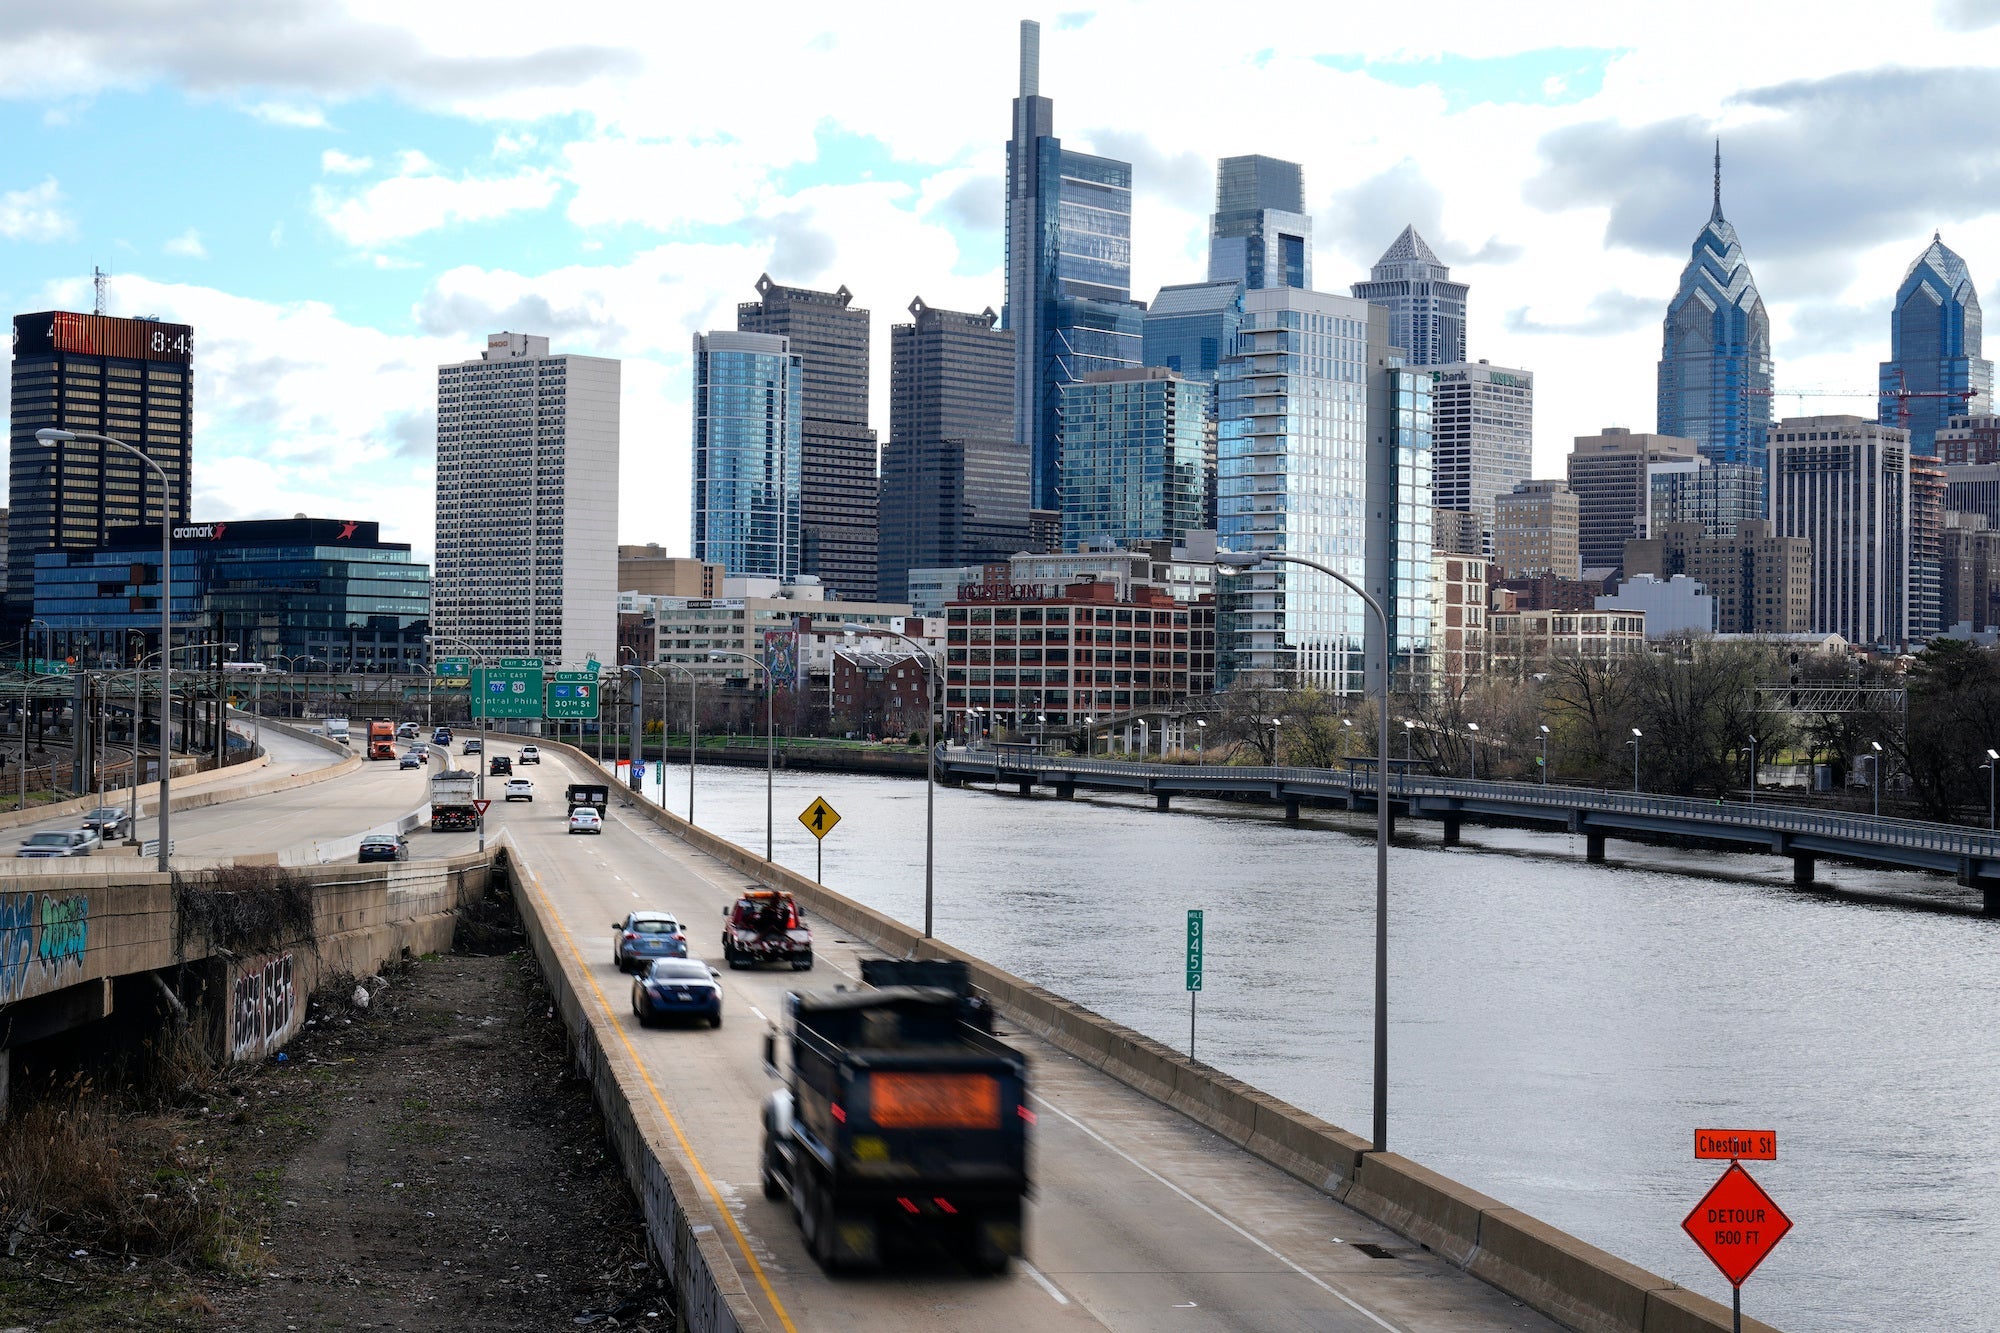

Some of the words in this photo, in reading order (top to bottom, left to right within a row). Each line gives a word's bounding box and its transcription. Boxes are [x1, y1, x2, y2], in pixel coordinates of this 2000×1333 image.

[1442, 371, 1467, 382] bank
[173, 524, 214, 539] aramark
[1005, 583, 1046, 599] POINT
[491, 684, 504, 692] 676
[513, 683, 524, 691] 30
[555, 700, 578, 708] 30TH
[634, 769, 644, 777] 76
[1188, 911, 1203, 919] MILE
[1700, 1136, 1752, 1153] Chestnut
[1760, 1137, 1772, 1153] St
[1707, 1209, 1765, 1223] DETOUR
[1715, 1230, 1741, 1245] 1500
[1745, 1231, 1759, 1245] FT
